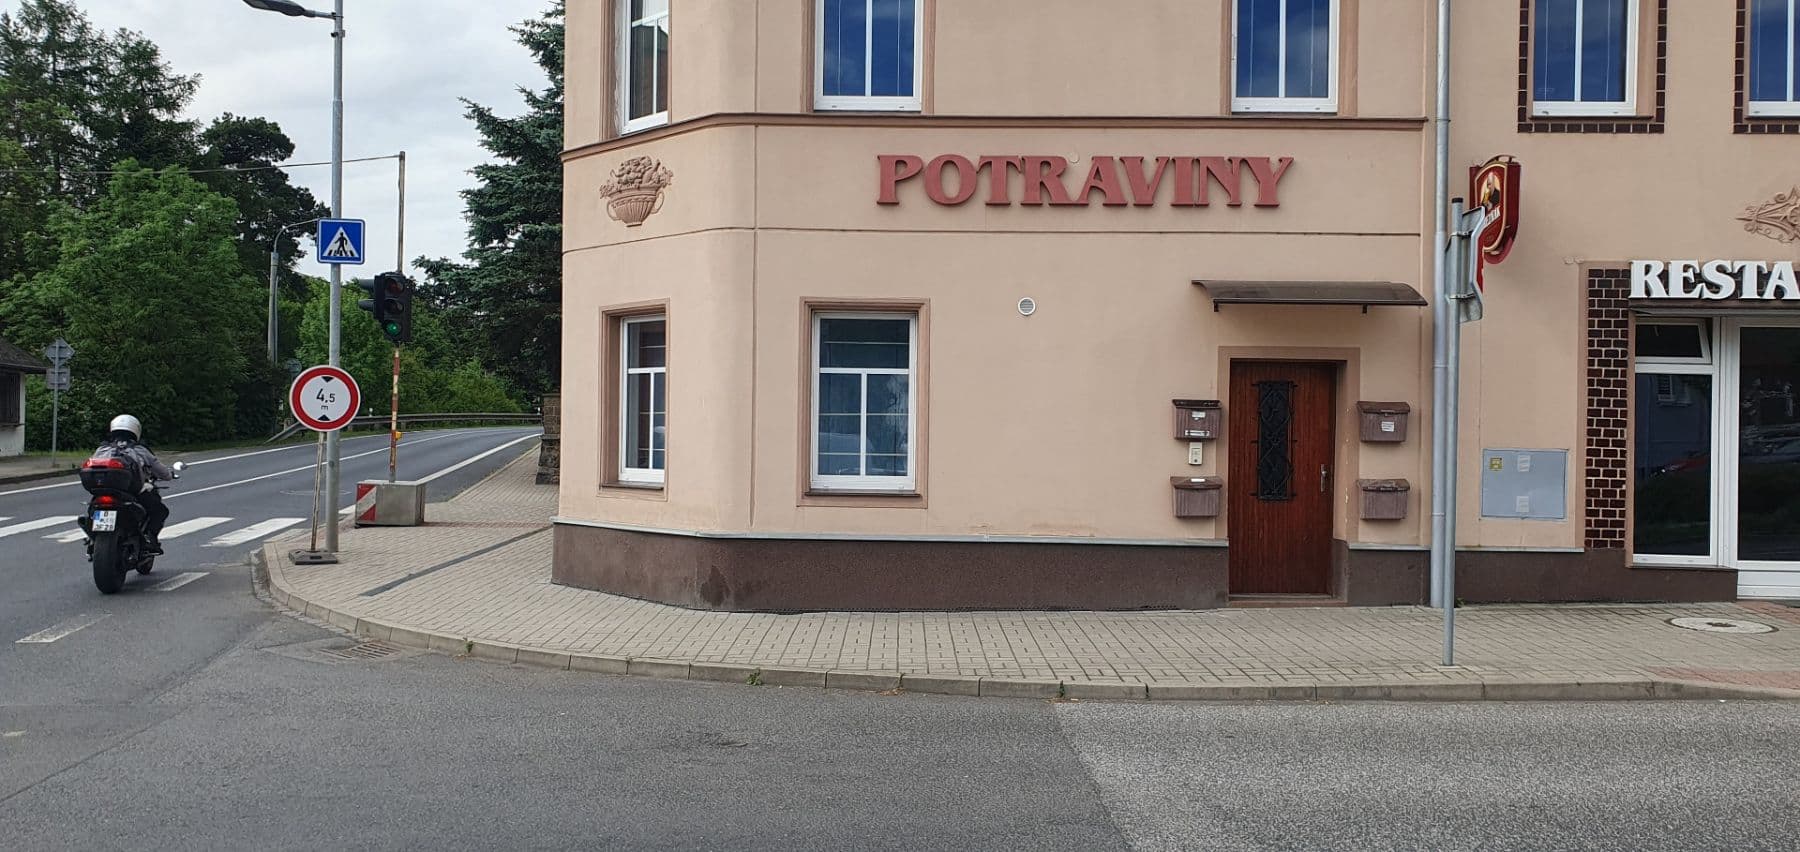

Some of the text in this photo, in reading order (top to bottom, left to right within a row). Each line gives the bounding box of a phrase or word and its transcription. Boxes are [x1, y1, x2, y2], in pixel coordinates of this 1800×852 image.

[876, 153, 1294, 207] POTRAVINY
[1628, 259, 1800, 300] RESTA
[316, 388, 336, 403] 4,5
